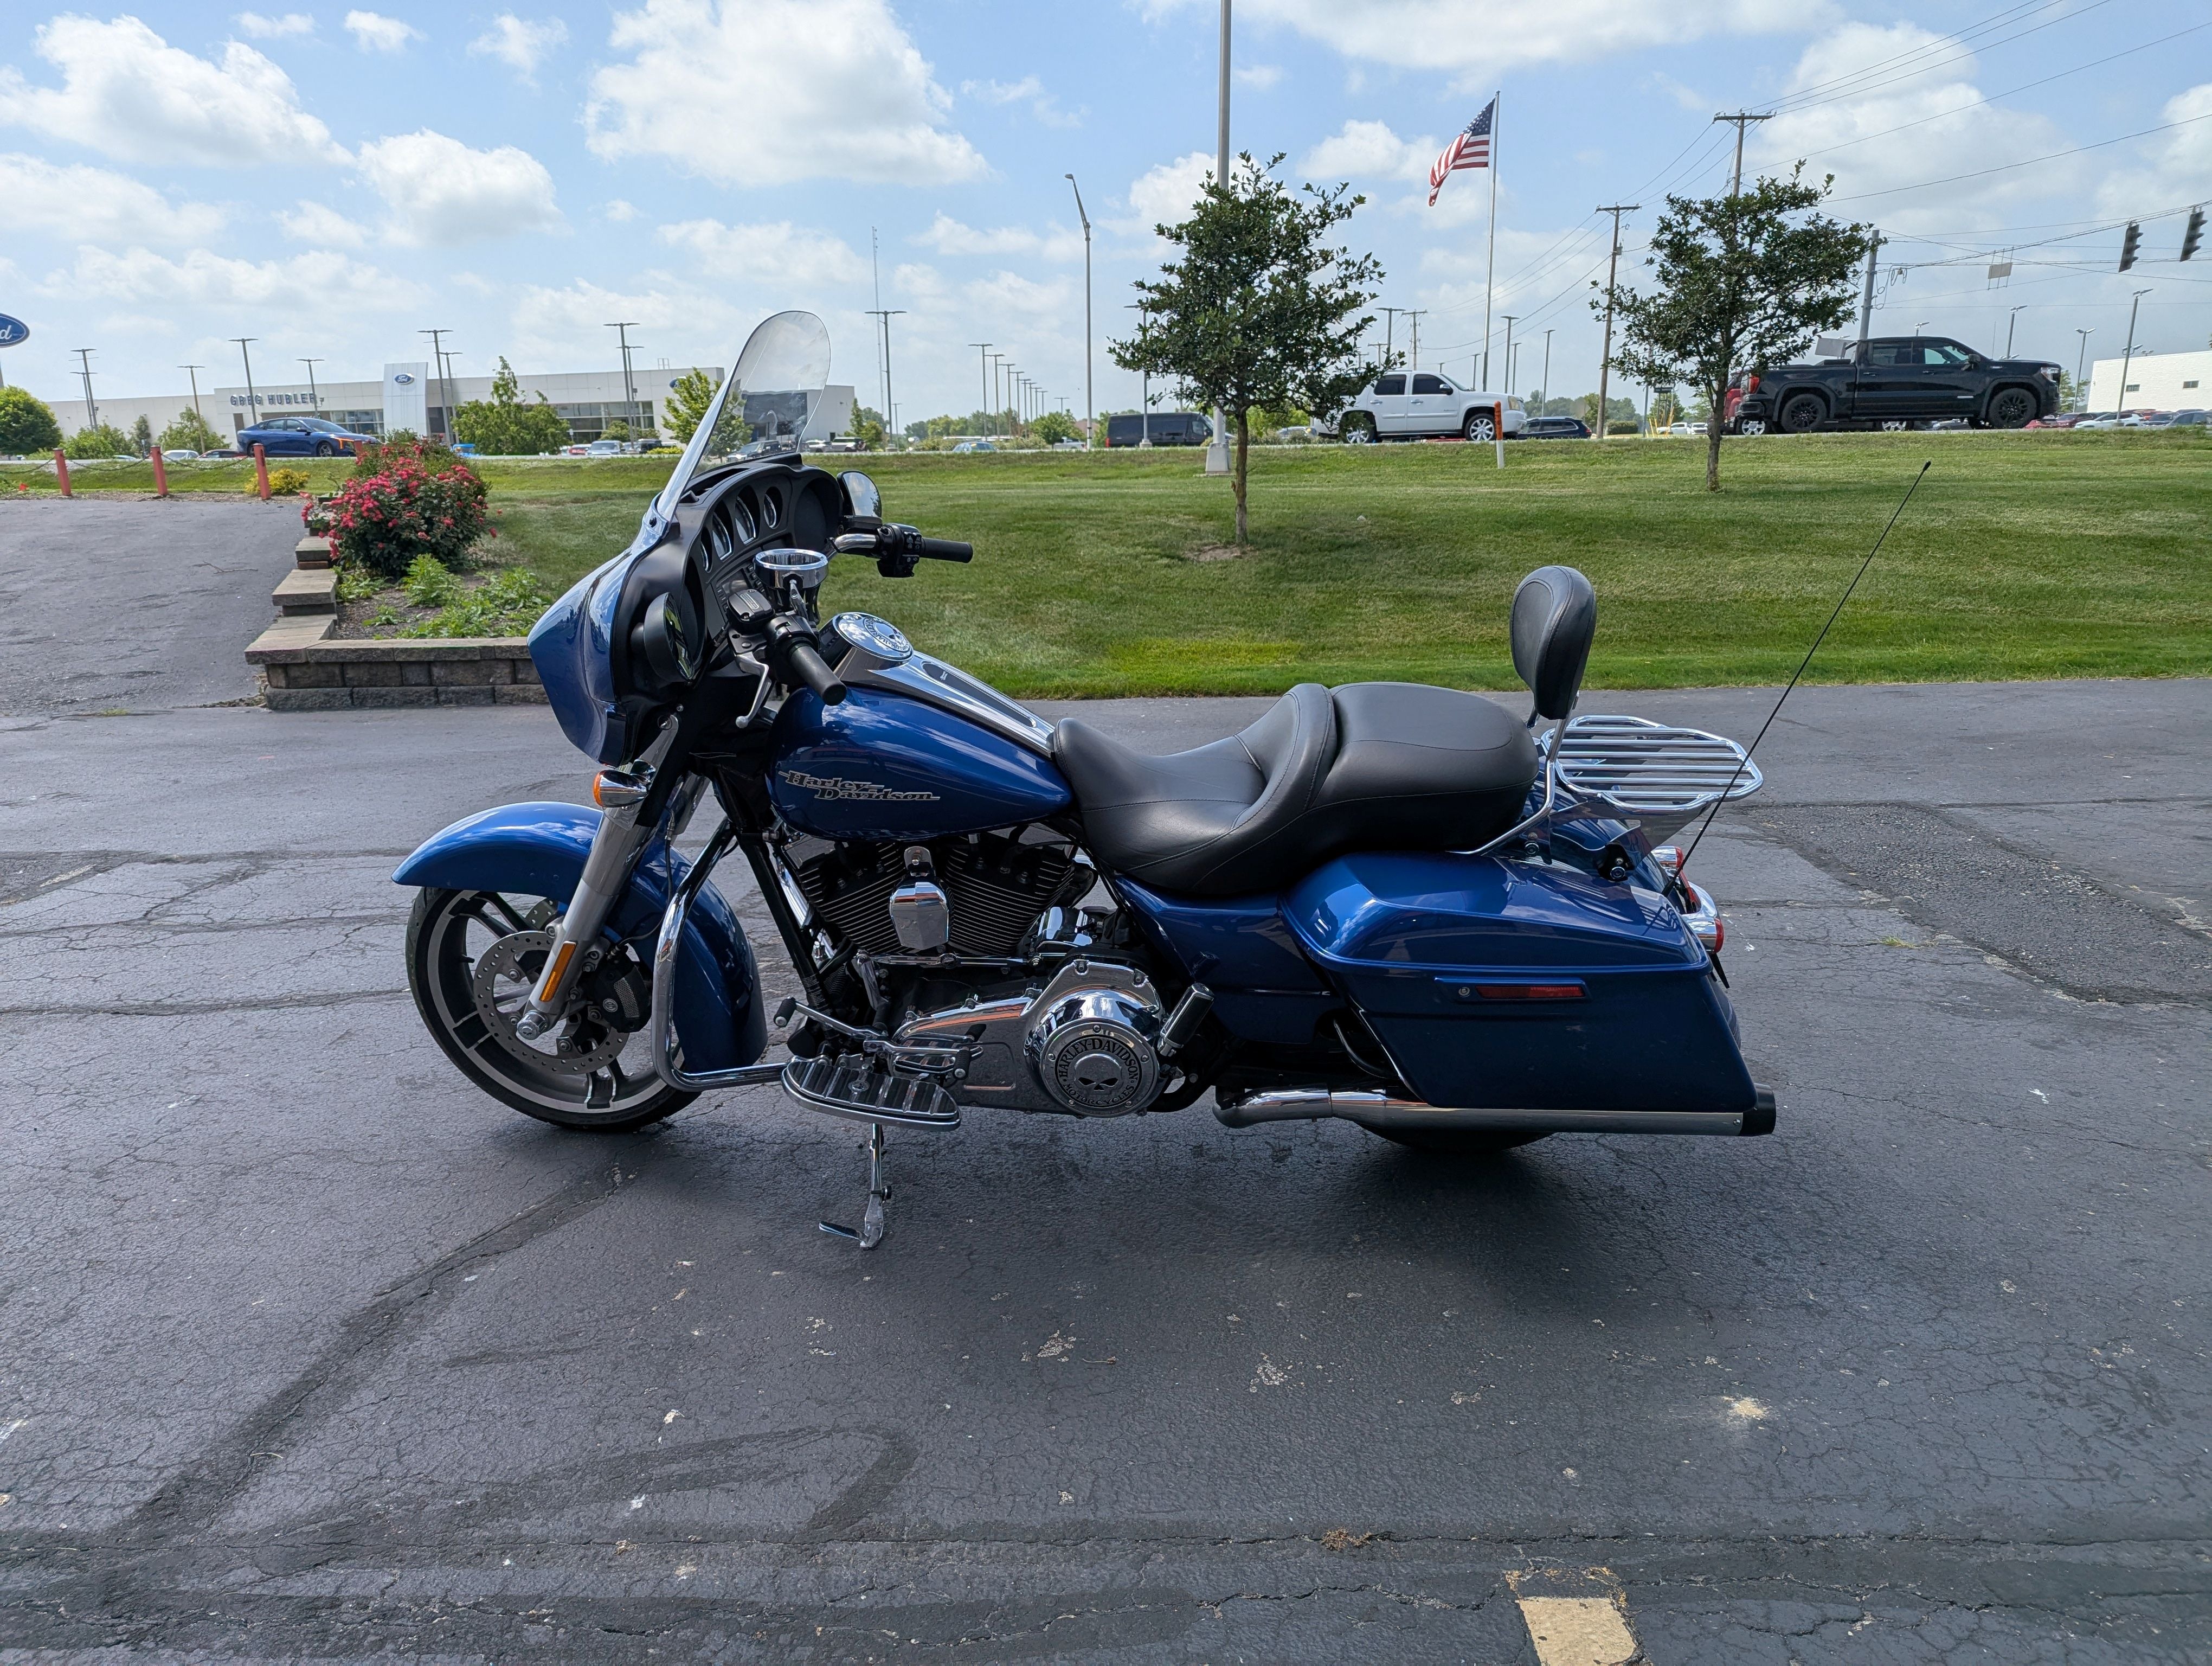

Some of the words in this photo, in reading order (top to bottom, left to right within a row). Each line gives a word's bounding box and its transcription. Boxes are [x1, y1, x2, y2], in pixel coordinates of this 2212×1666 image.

[230, 395, 262, 405] GREG
[267, 393, 315, 405] HUBLER
[779, 770, 884, 791] Harley
[814, 787, 941, 800] Davidson
[1059, 1038, 1138, 1080] HARLEY-DAVIDSON
[1064, 1084, 1135, 1105] MOTORCYCLES
